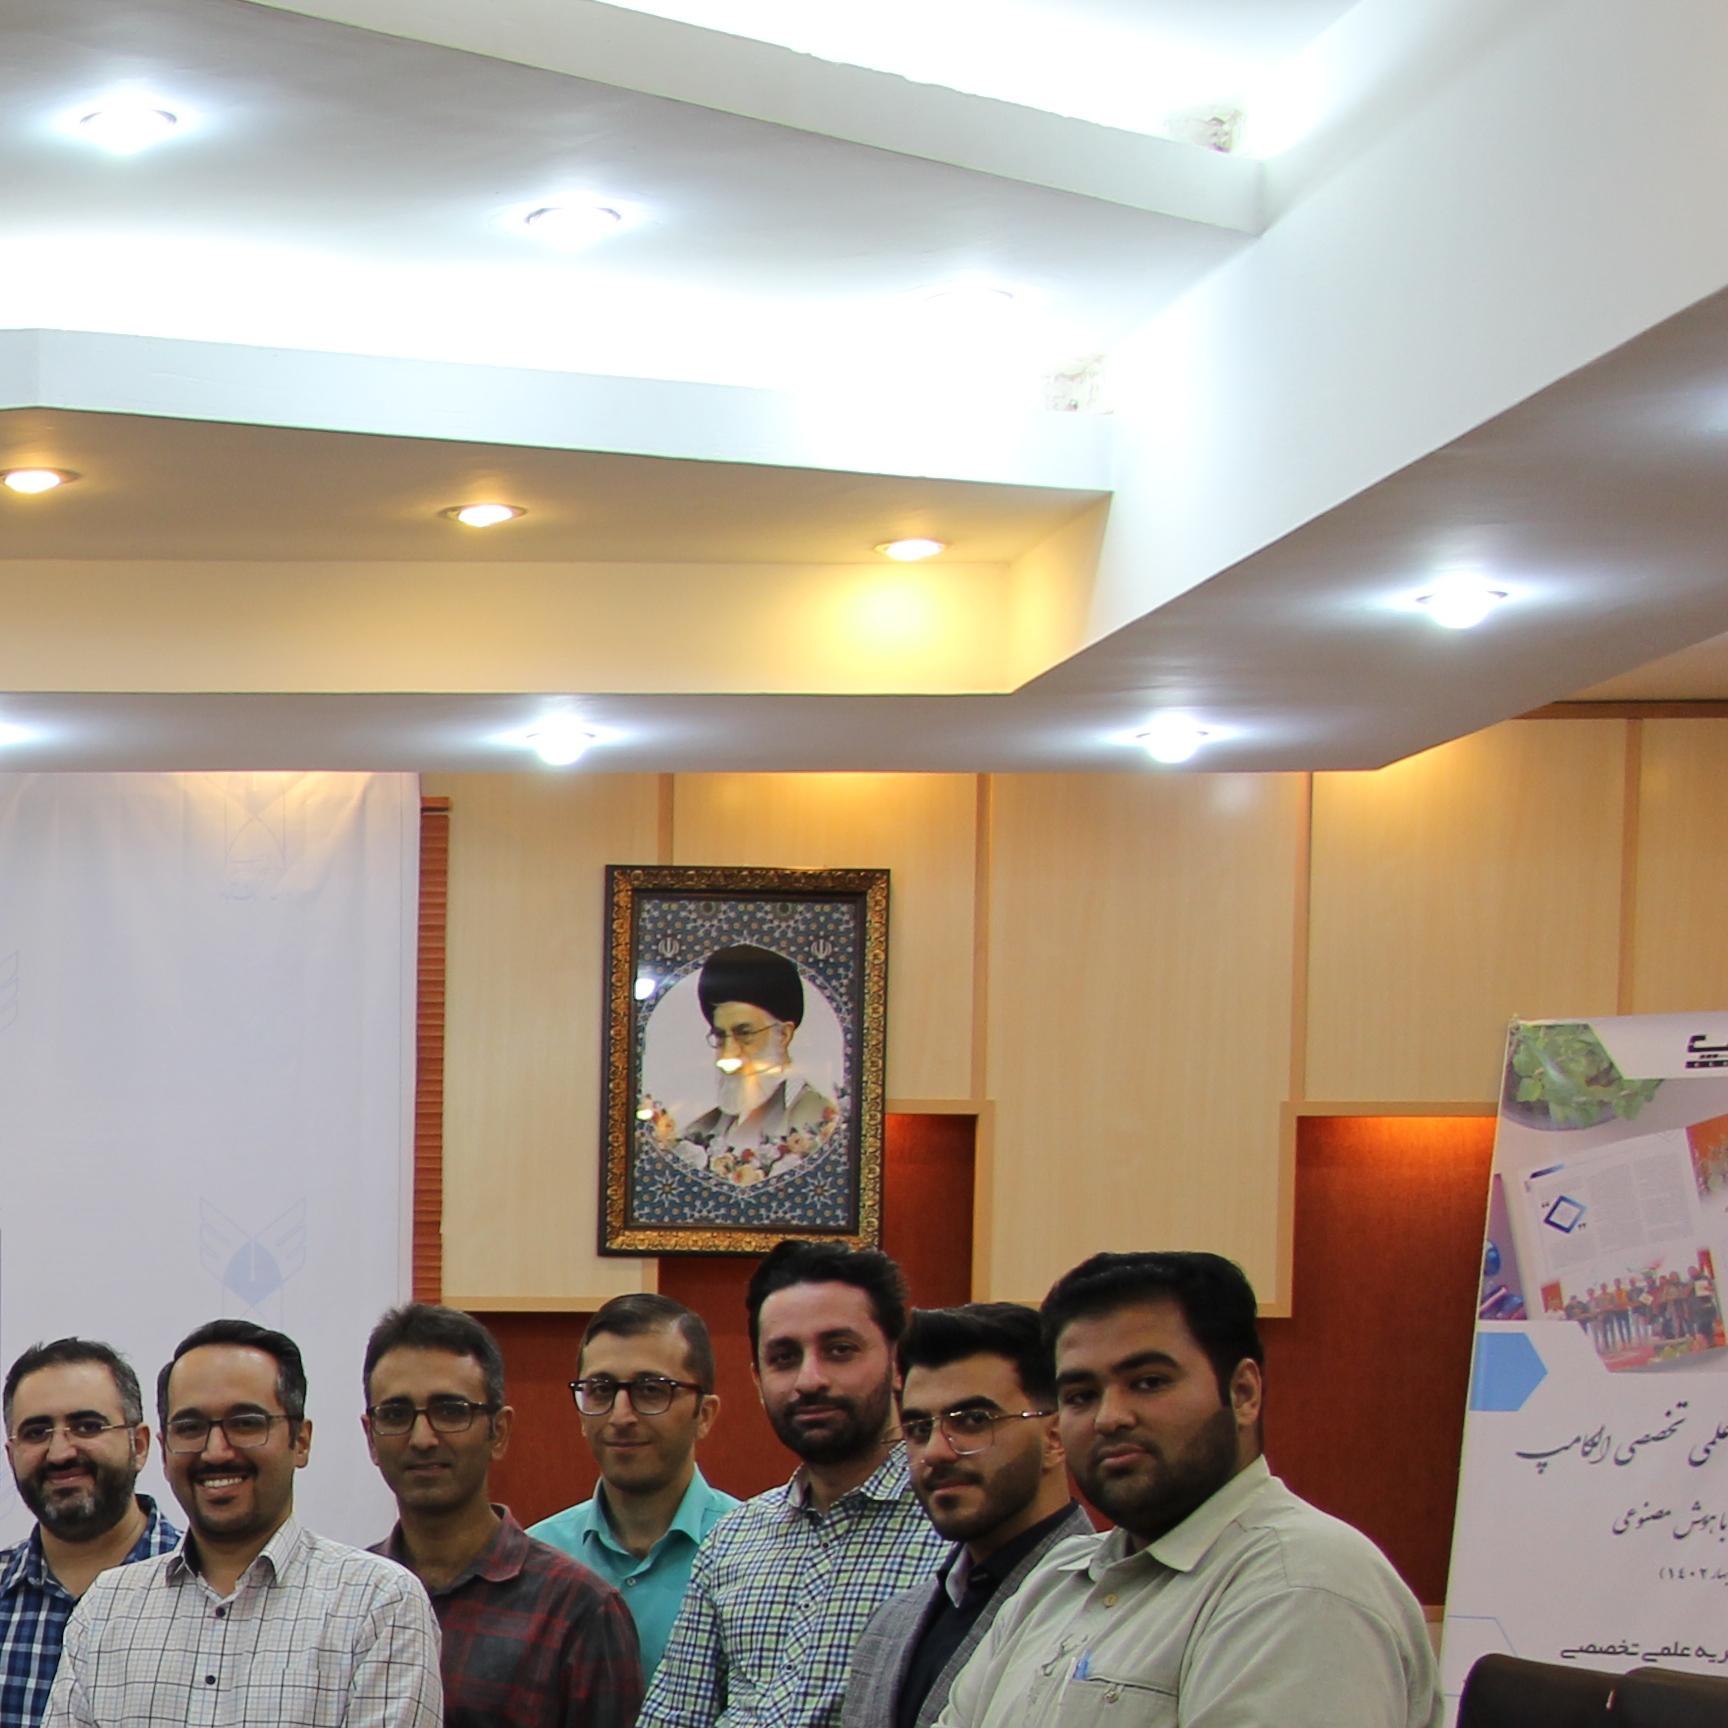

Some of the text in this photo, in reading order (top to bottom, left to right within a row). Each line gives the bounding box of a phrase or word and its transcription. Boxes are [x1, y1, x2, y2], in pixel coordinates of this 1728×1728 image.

[1613, 1400, 1689, 1467] تخصصی
[1612, 1501, 1672, 1536] مصنوعی
[1560, 1638, 1640, 1659] تخصصی
[1641, 1640, 1691, 1663] علمی
